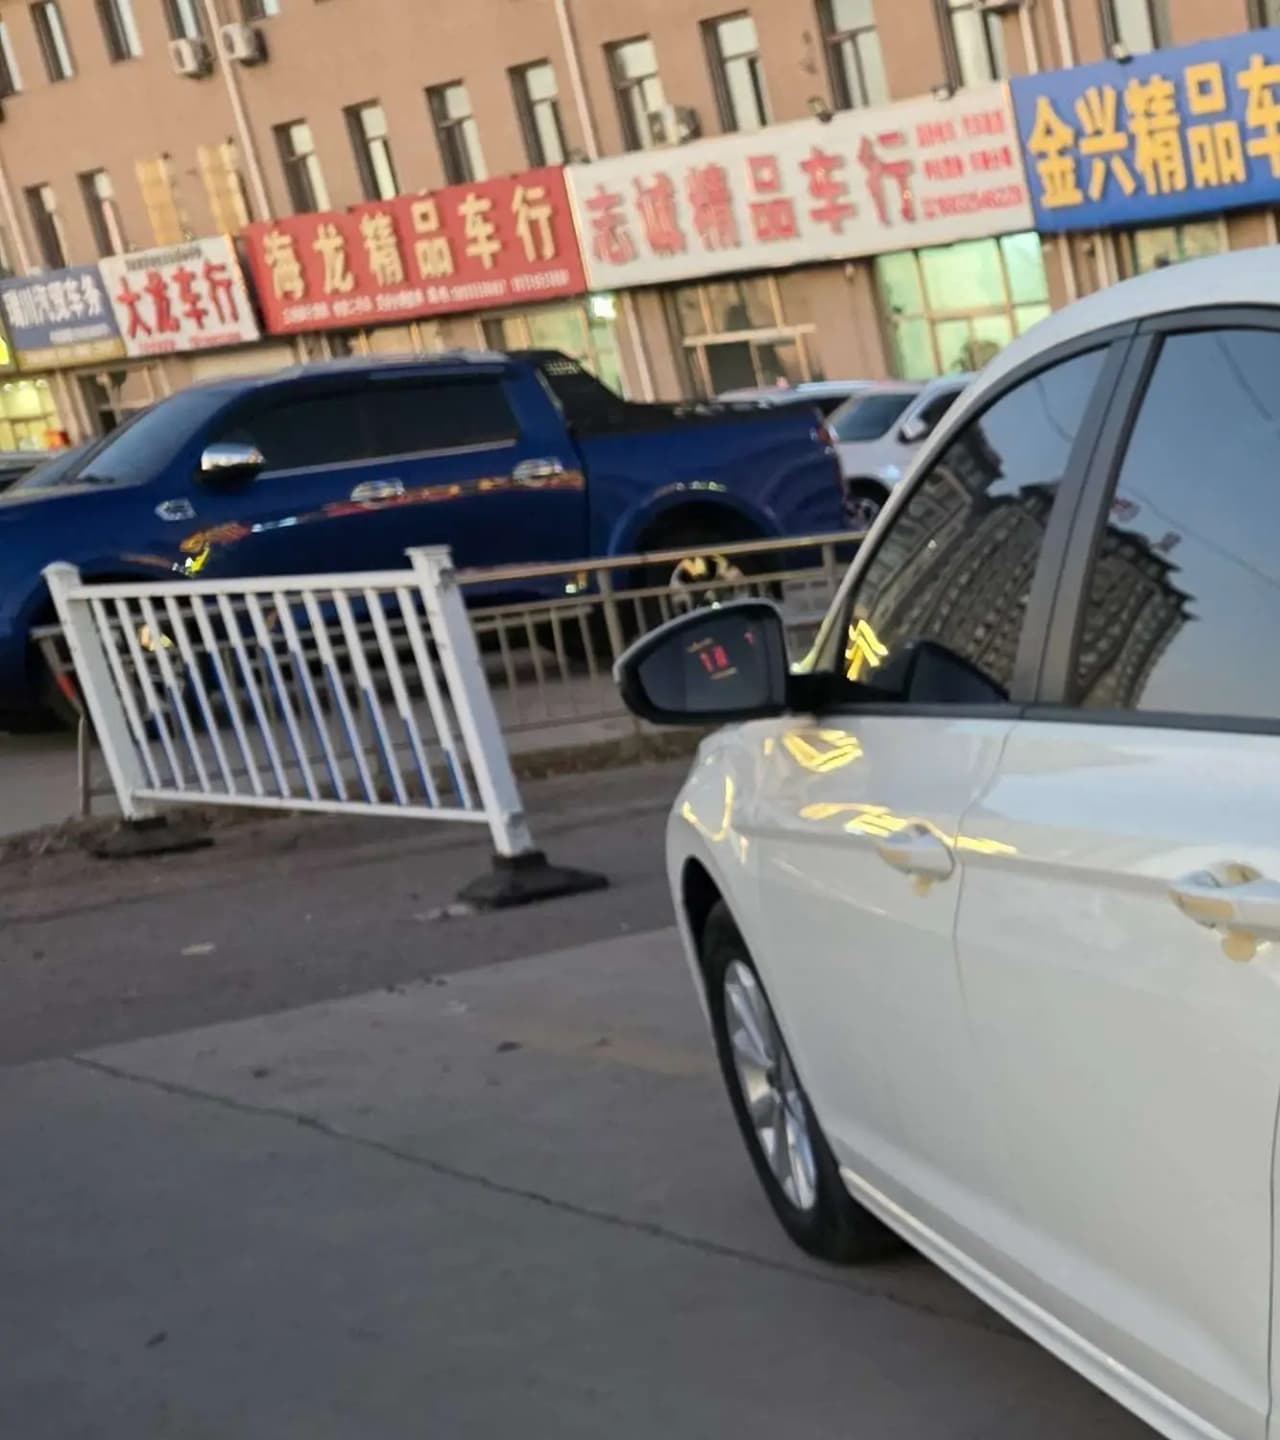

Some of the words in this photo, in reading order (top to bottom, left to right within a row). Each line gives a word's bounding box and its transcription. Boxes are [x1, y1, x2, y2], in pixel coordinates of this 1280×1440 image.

[262, 184, 558, 300] 海龙精品车行
